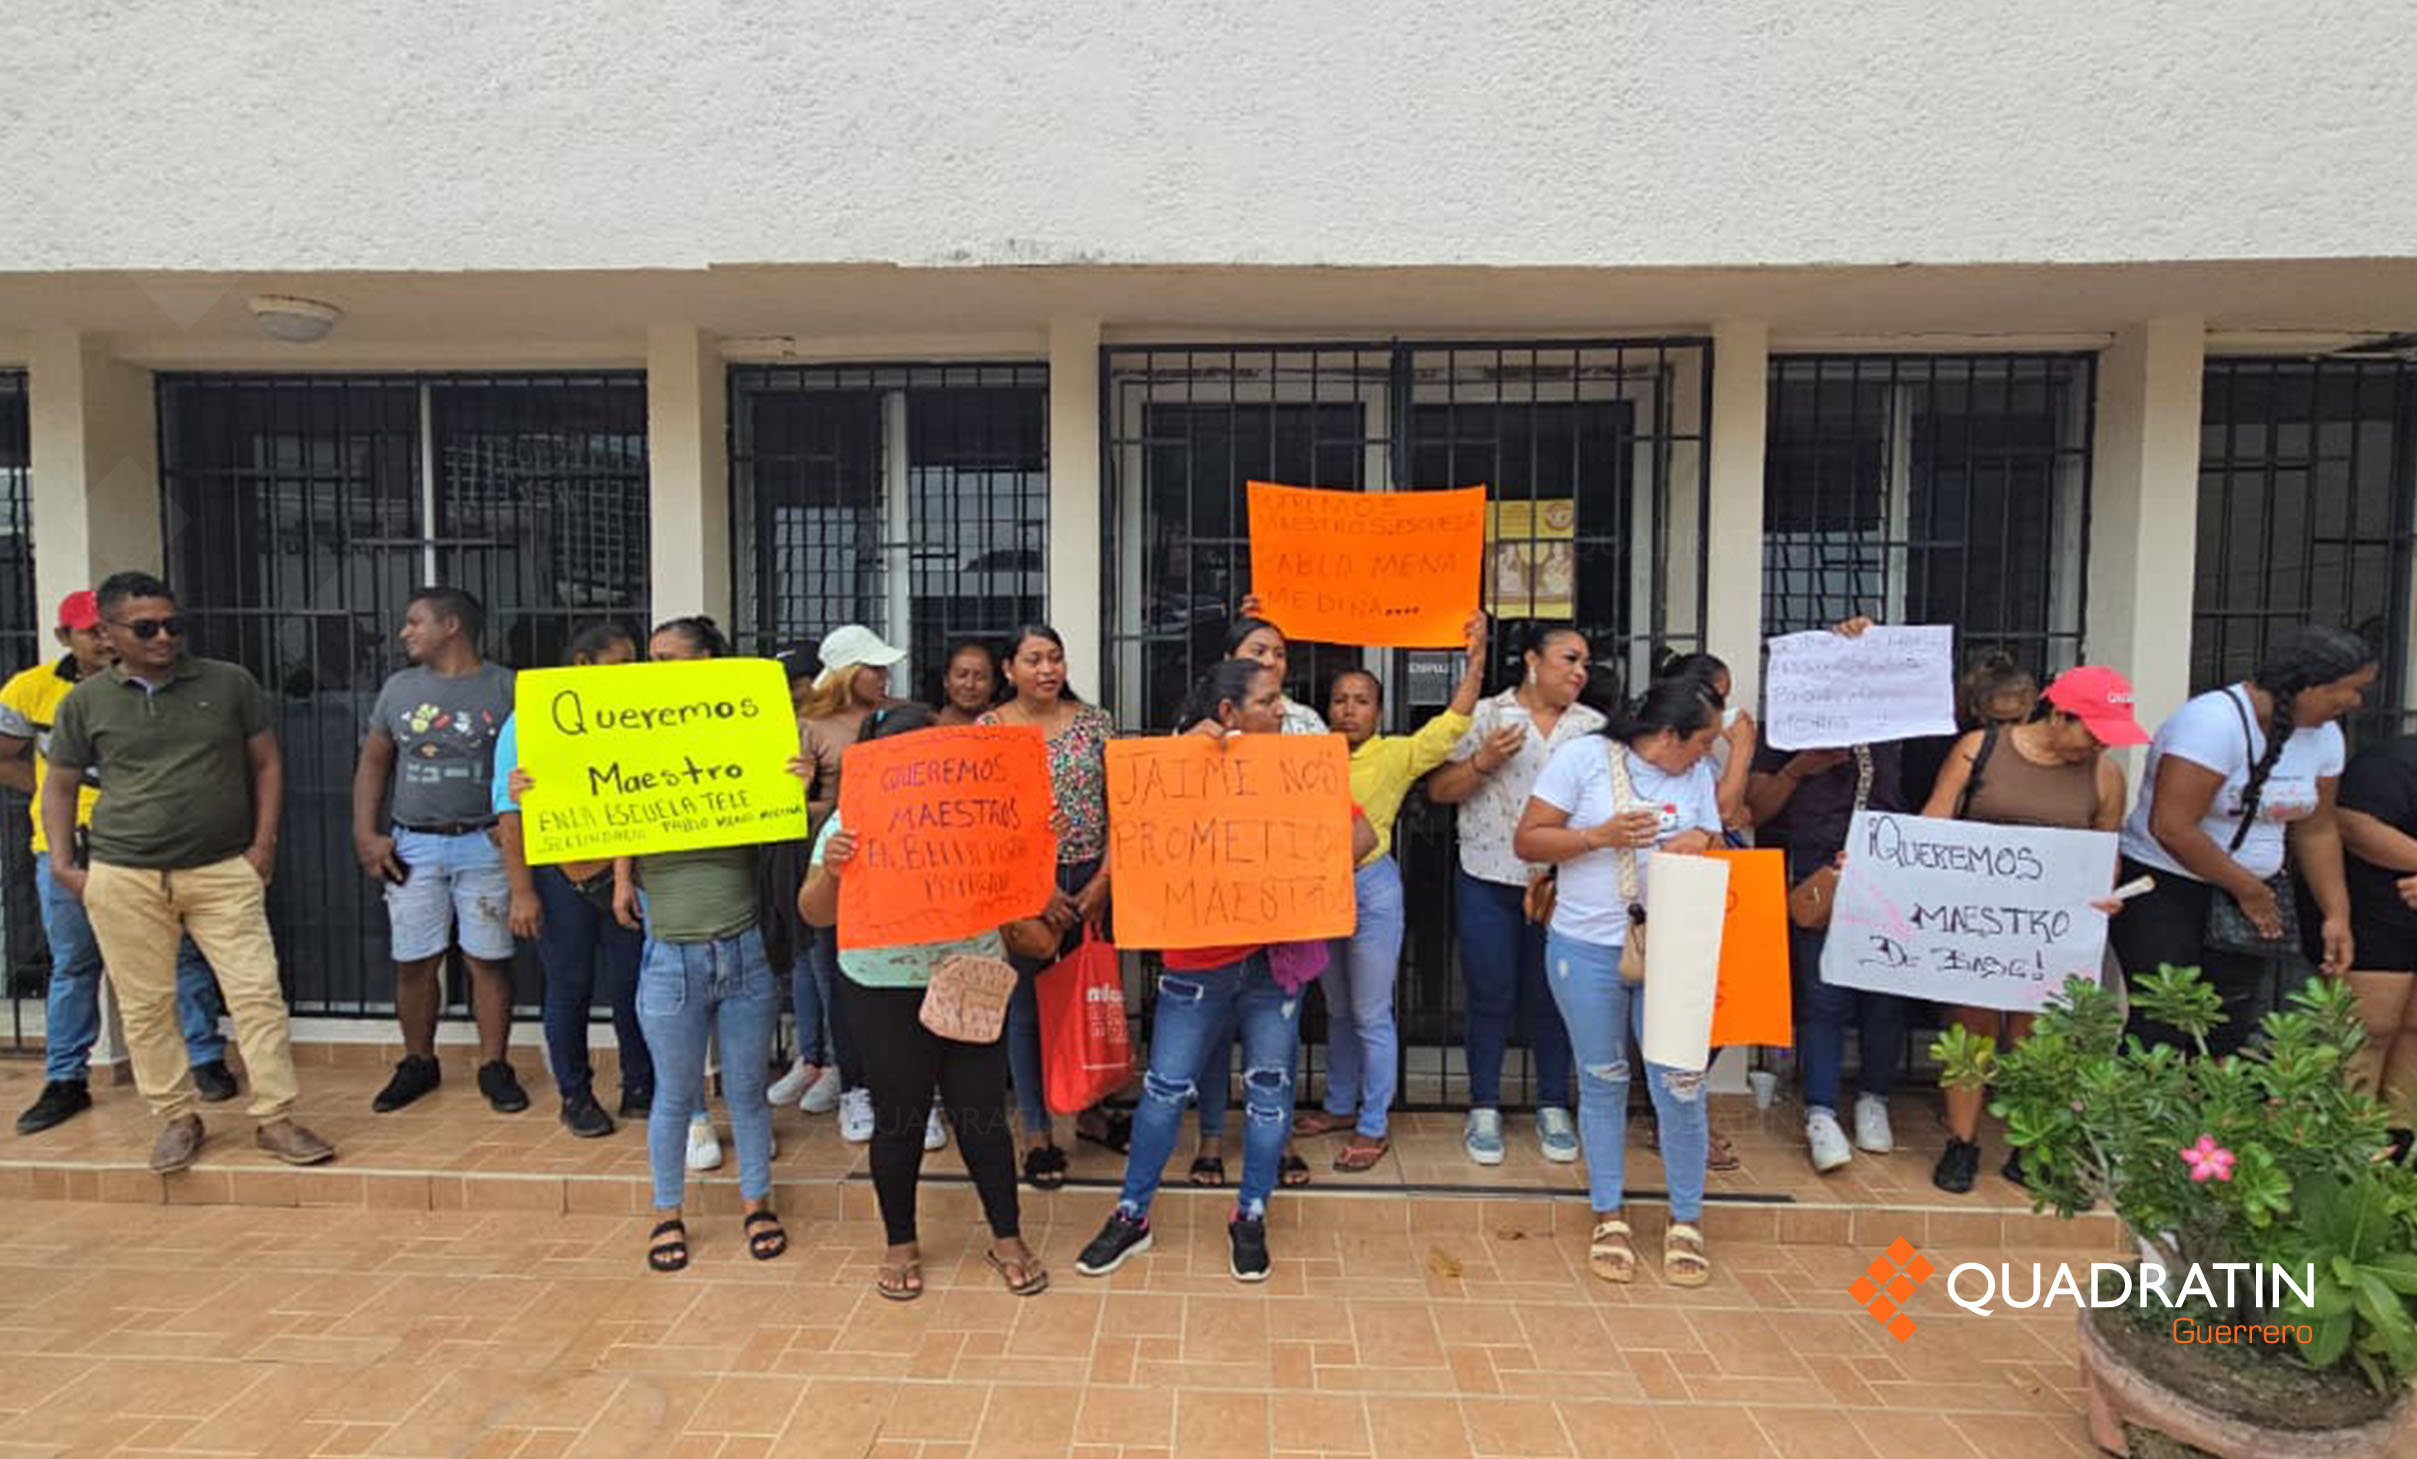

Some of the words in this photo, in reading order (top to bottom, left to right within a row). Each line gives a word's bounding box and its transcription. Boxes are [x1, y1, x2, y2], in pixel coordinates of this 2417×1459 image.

[552, 690, 759, 736] Queremos
[587, 756, 744, 796] Maestro
[880, 753, 1008, 792] QUEREMOS
[1115, 751, 1259, 806] JAIME
[1910, 902, 2071, 944] MAESTRO
